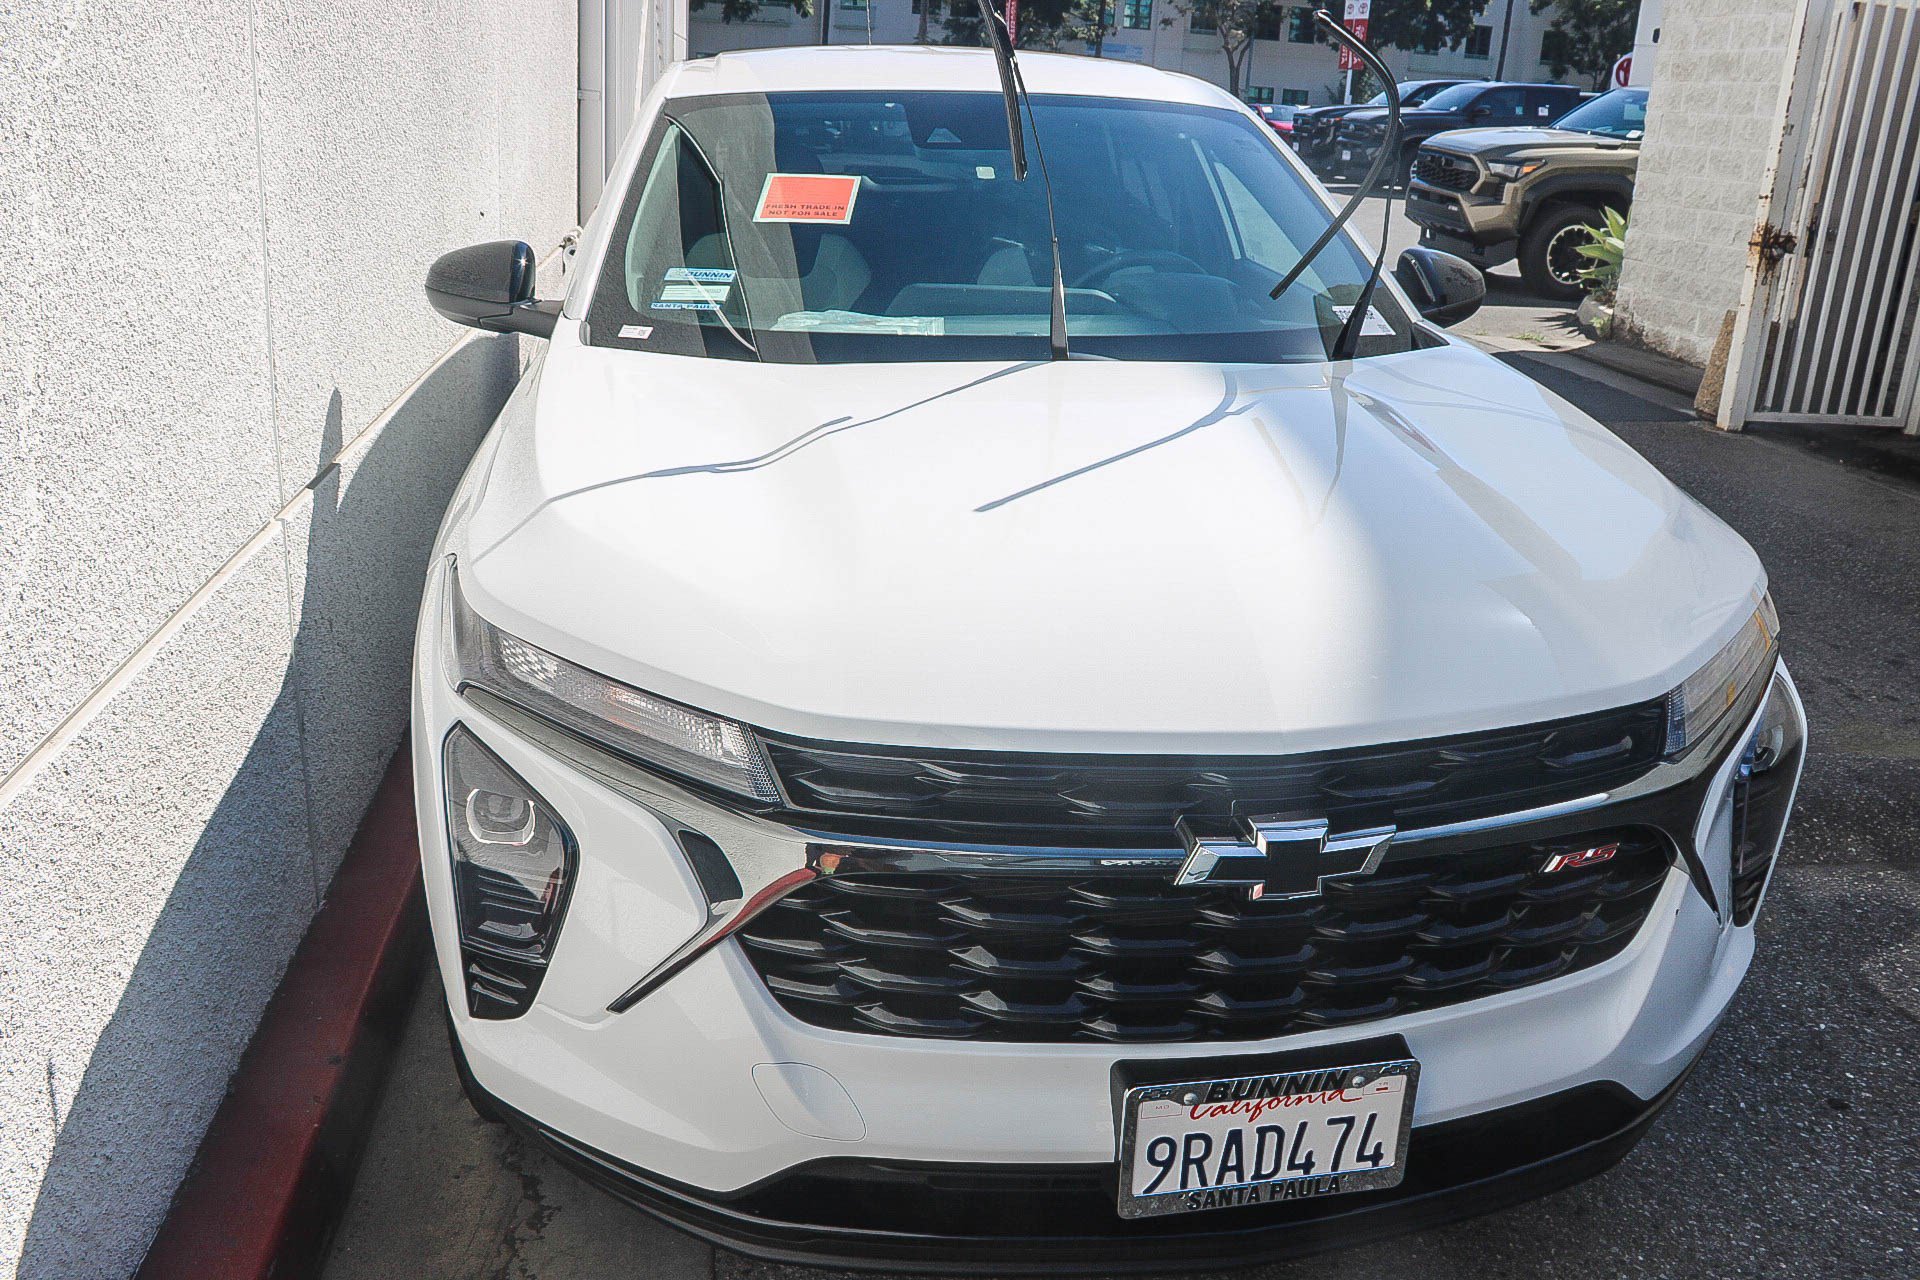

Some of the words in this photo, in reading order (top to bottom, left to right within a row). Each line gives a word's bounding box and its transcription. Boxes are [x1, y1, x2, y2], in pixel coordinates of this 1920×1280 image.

[1204, 1069, 1351, 1103] BUNNIN
[1189, 1088, 1362, 1123] California
[1142, 1113, 1385, 1194] 9RAD474
[1186, 1182, 1262, 1211] SANTA
[1272, 1175, 1342, 1203] PAULA
